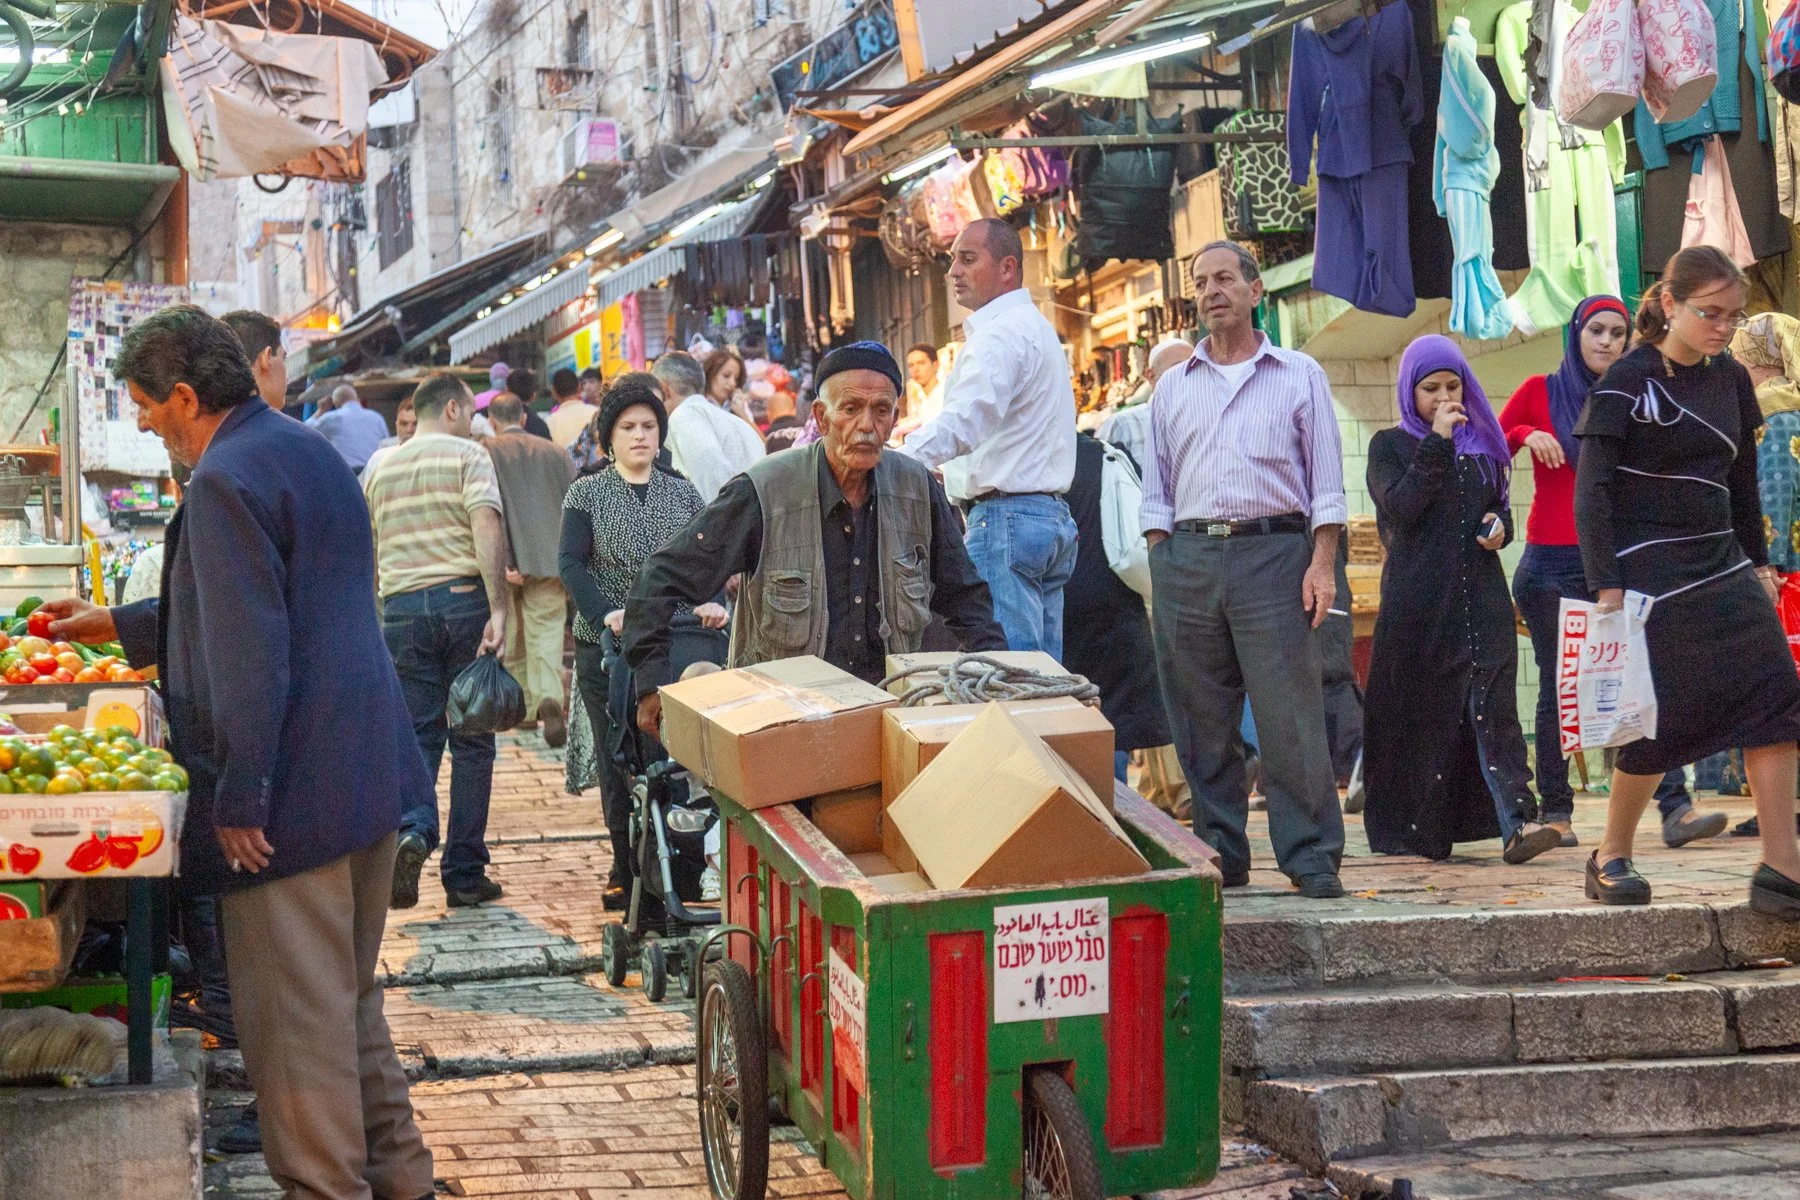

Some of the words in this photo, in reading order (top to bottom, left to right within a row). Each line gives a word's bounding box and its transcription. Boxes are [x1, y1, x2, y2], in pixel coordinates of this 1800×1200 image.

[1560, 614, 1586, 750] BERNINA
[997, 943, 1035, 969] שכם
[1037, 940, 1074, 965] שער
[1074, 934, 1105, 963] סבל
